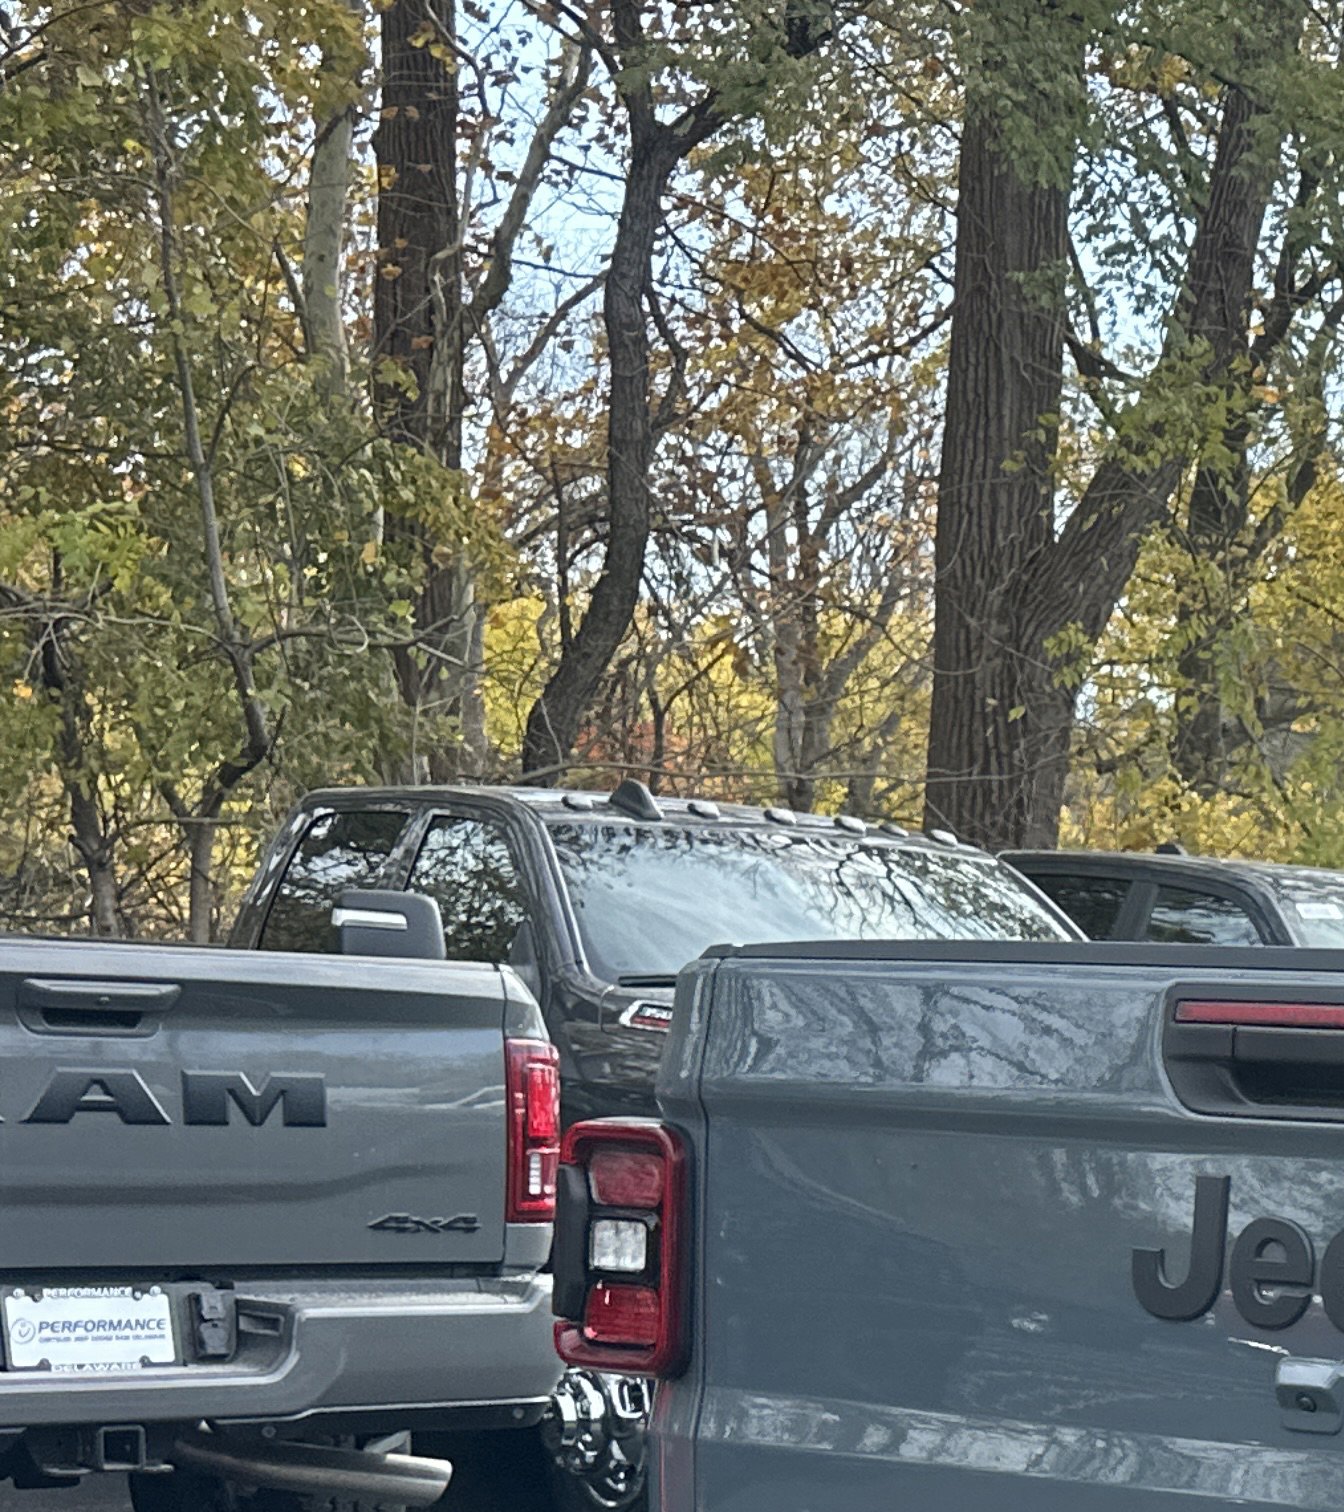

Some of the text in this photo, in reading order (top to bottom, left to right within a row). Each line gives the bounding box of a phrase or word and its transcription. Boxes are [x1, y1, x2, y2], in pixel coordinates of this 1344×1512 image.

[0, 1067, 328, 1127] AM
[366, 1212, 482, 1234] 4x4
[42, 1286, 133, 1299] PERFORMANCE
[38, 1318, 167, 1333] PERFORMANCE
